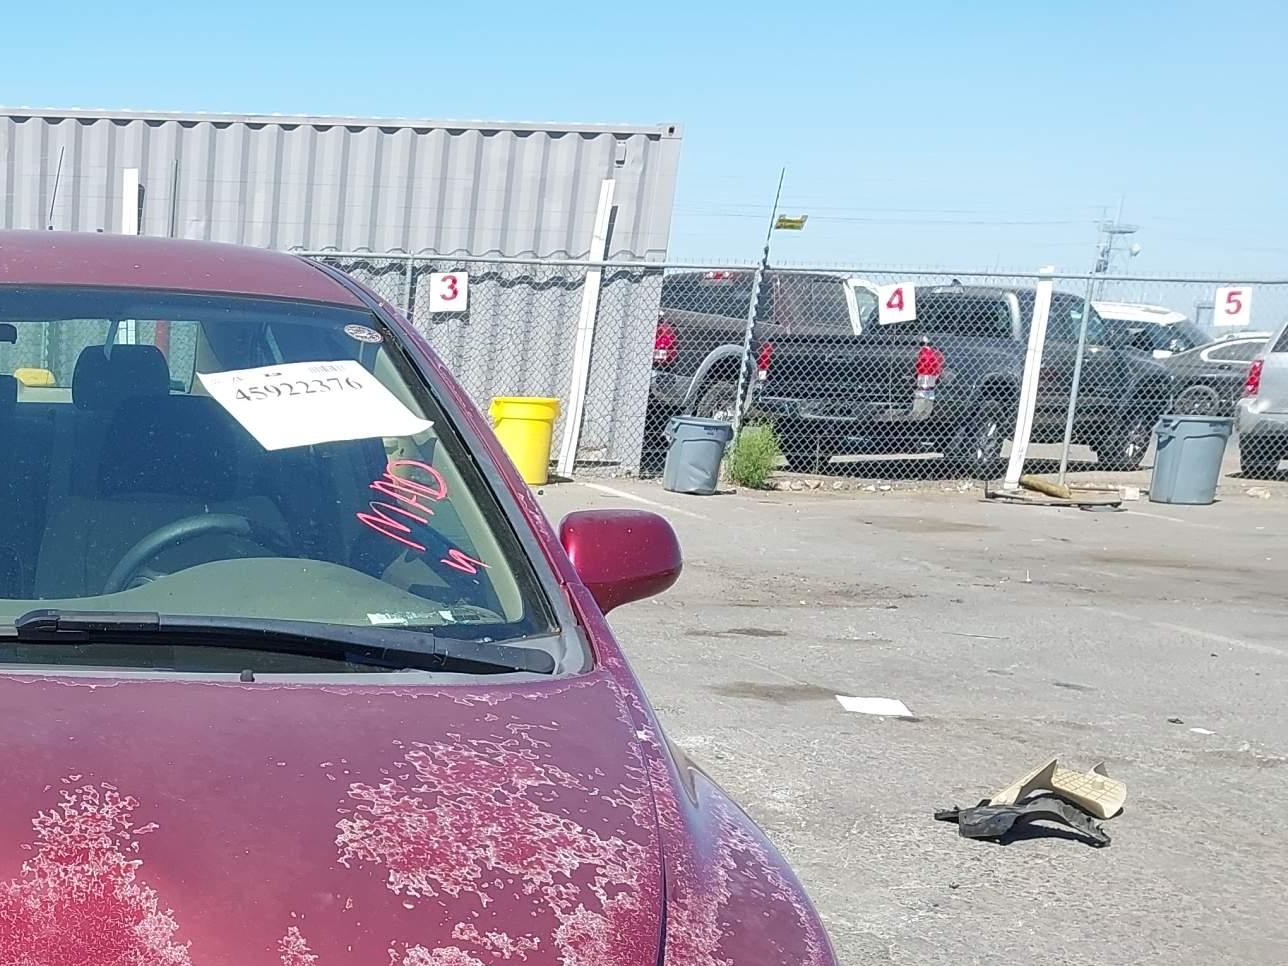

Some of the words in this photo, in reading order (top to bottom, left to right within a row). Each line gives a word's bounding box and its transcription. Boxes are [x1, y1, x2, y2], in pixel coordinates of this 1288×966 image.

[440, 275, 458, 301] 3
[886, 287, 904, 311] 4
[1224, 291, 1242, 315] 5
[235, 376, 363, 401] 45922376
